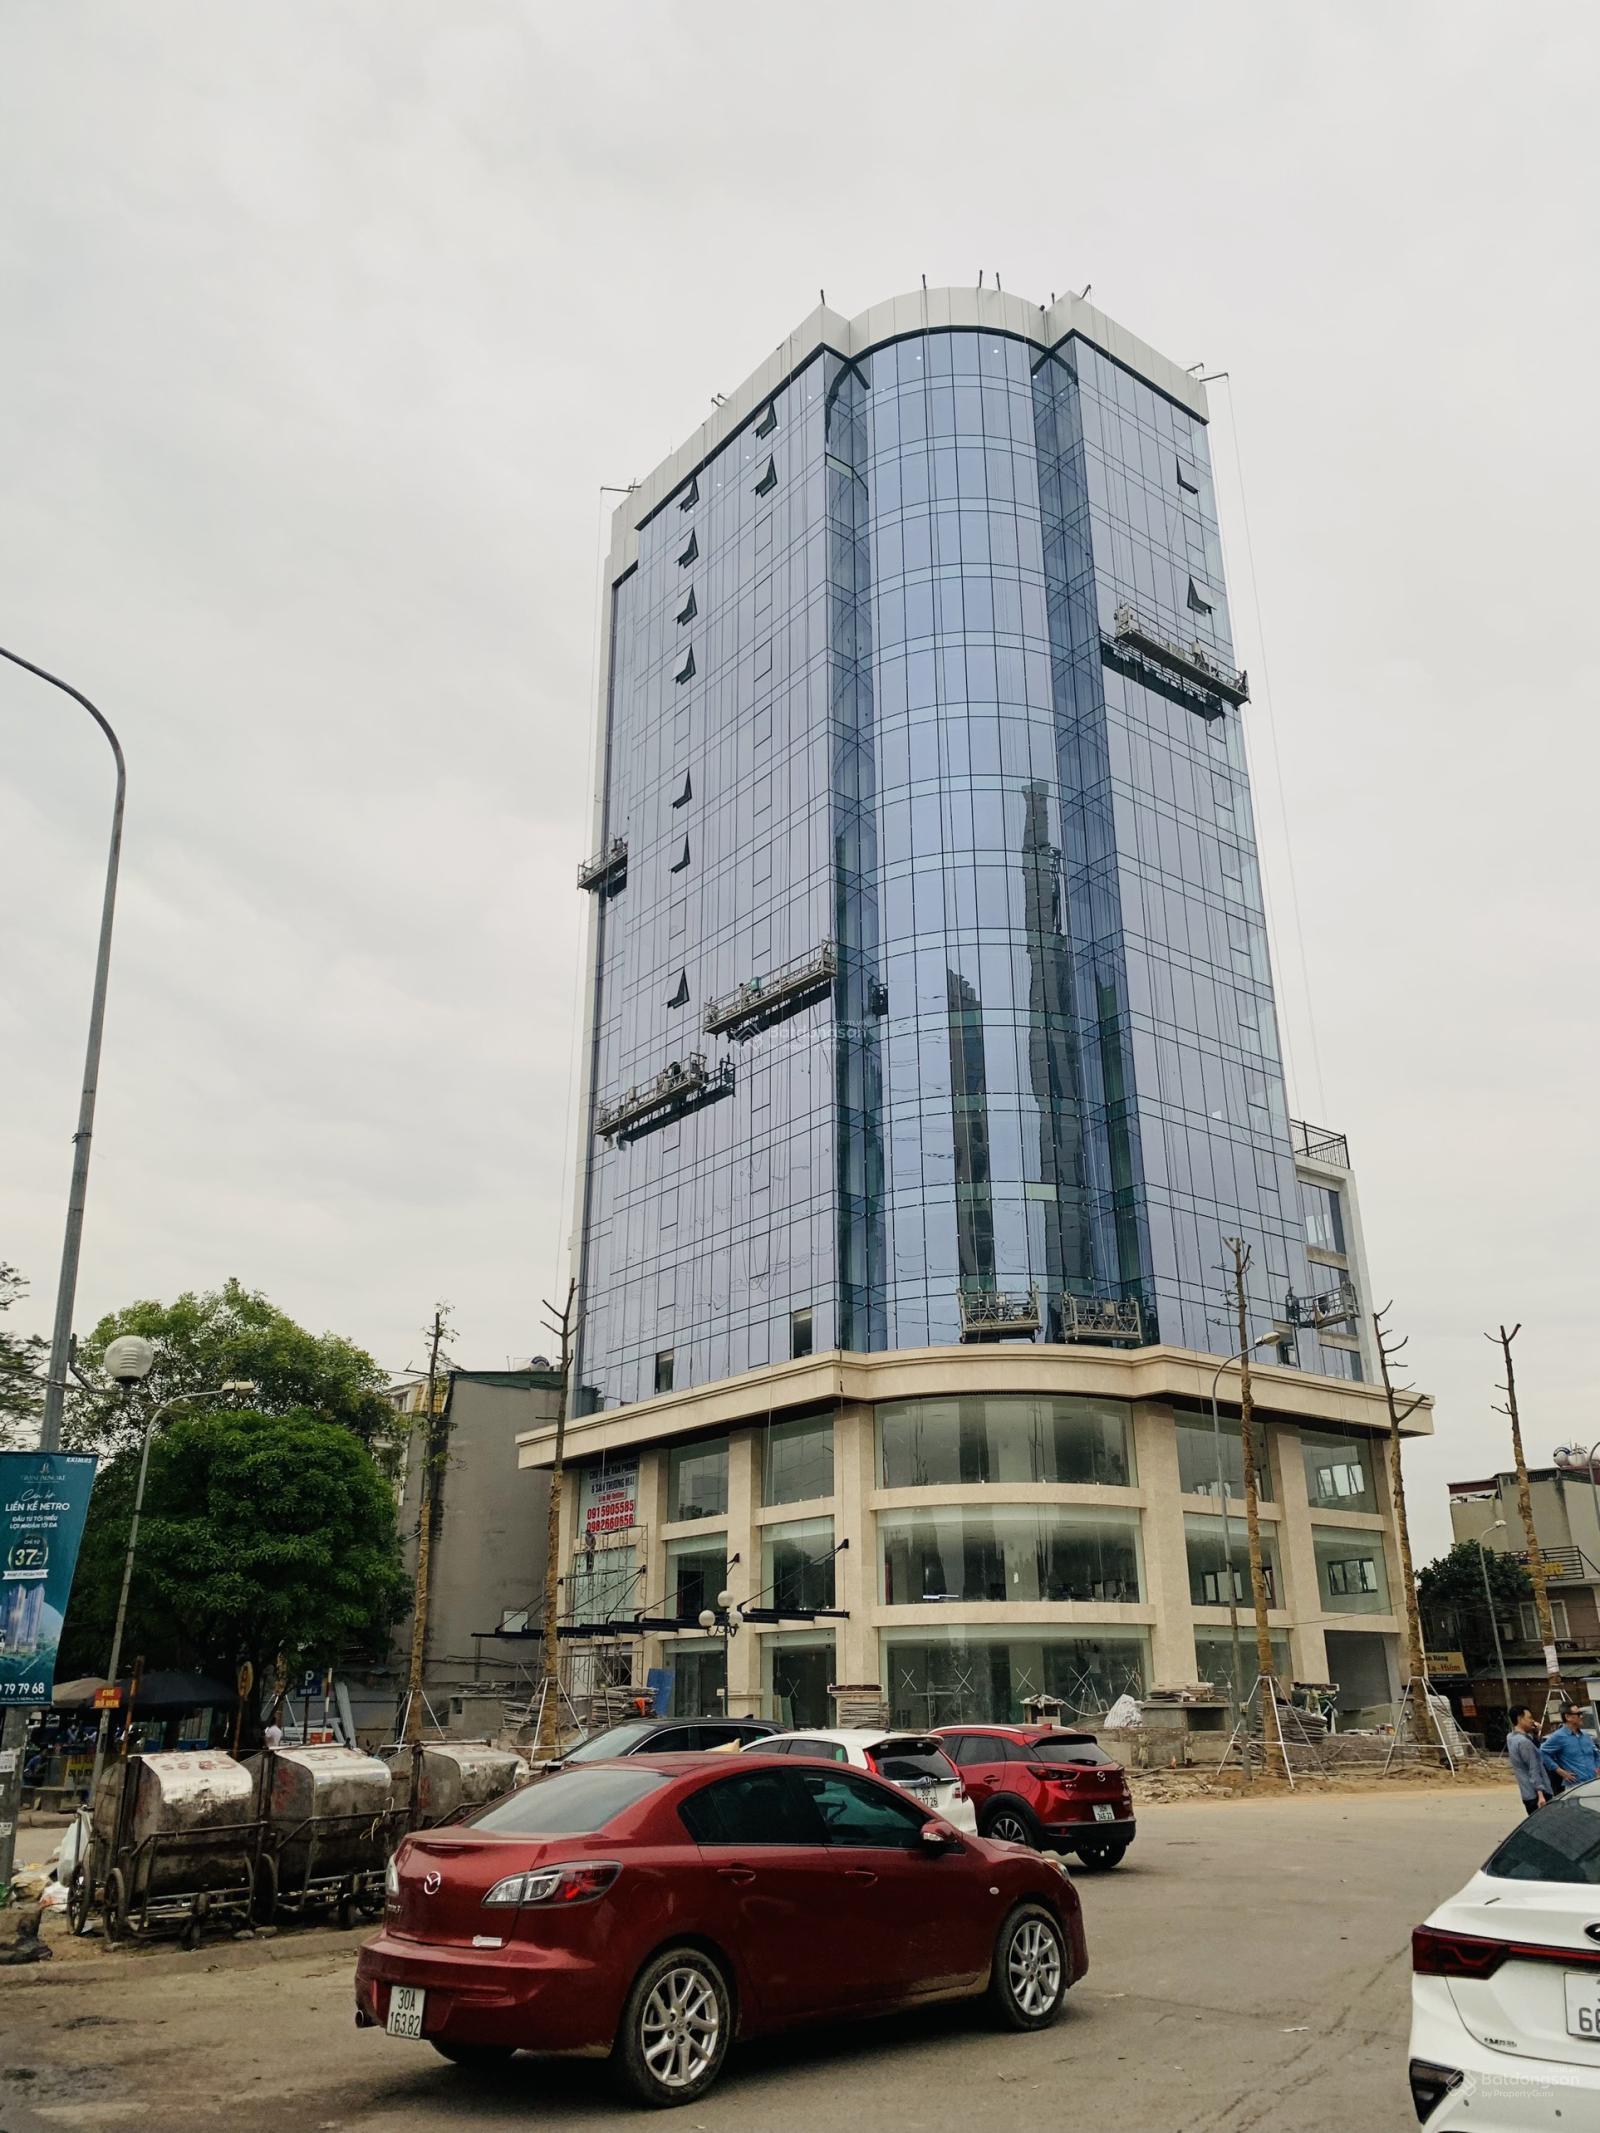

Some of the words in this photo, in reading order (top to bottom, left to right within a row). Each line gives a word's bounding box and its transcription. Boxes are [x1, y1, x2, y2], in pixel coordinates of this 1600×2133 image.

[39, 1502, 71, 1511] METRO
[587, 1500, 635, 1520] 0915905585
[15, 1549, 38, 1566] 37
[304, 1670, 314, 1686] P
[4, 1683, 16, 1694] 79
[18, 1683, 30, 1694] 79
[31, 1682, 45, 1694] 68
[398, 1989, 416, 2011] 30A
[390, 2012, 421, 2036] 163.82
